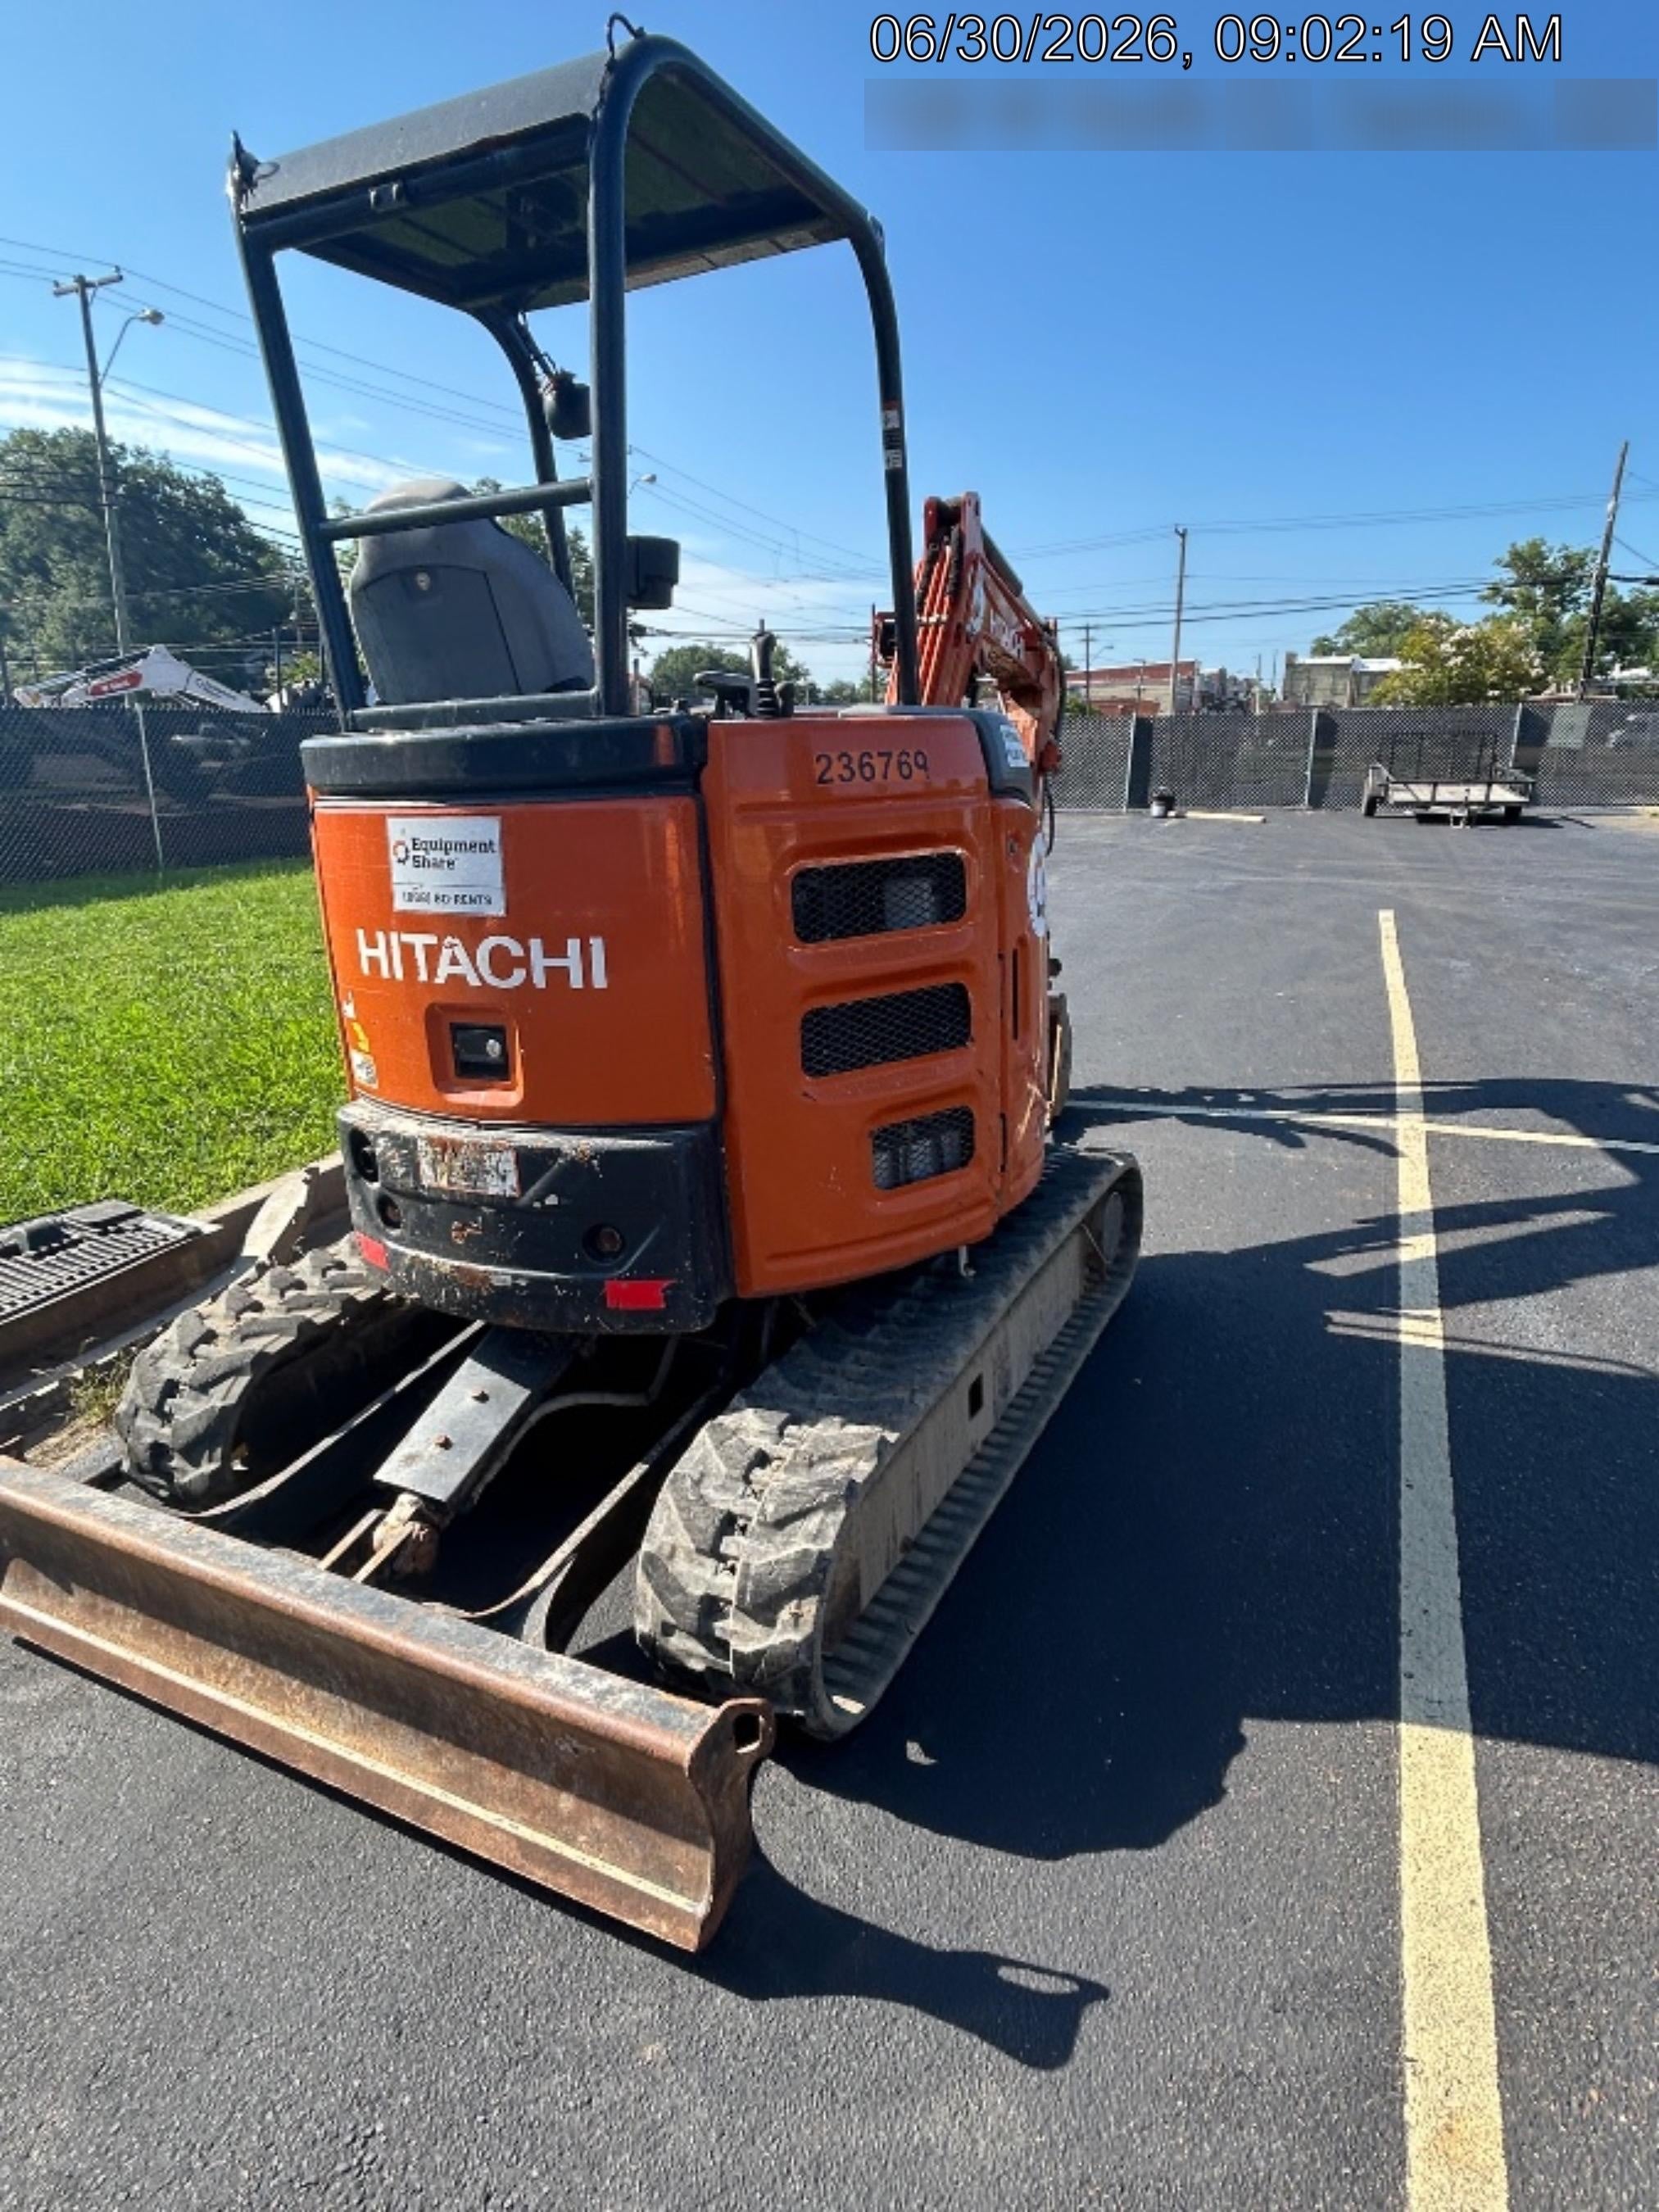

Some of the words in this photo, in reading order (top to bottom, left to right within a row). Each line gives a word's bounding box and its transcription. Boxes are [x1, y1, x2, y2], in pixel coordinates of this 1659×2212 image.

[815, 749, 930, 784] 236769
[411, 837, 497, 855] Equipment
[412, 854, 456, 870] Share
[356, 927, 609, 989] HITACHI
